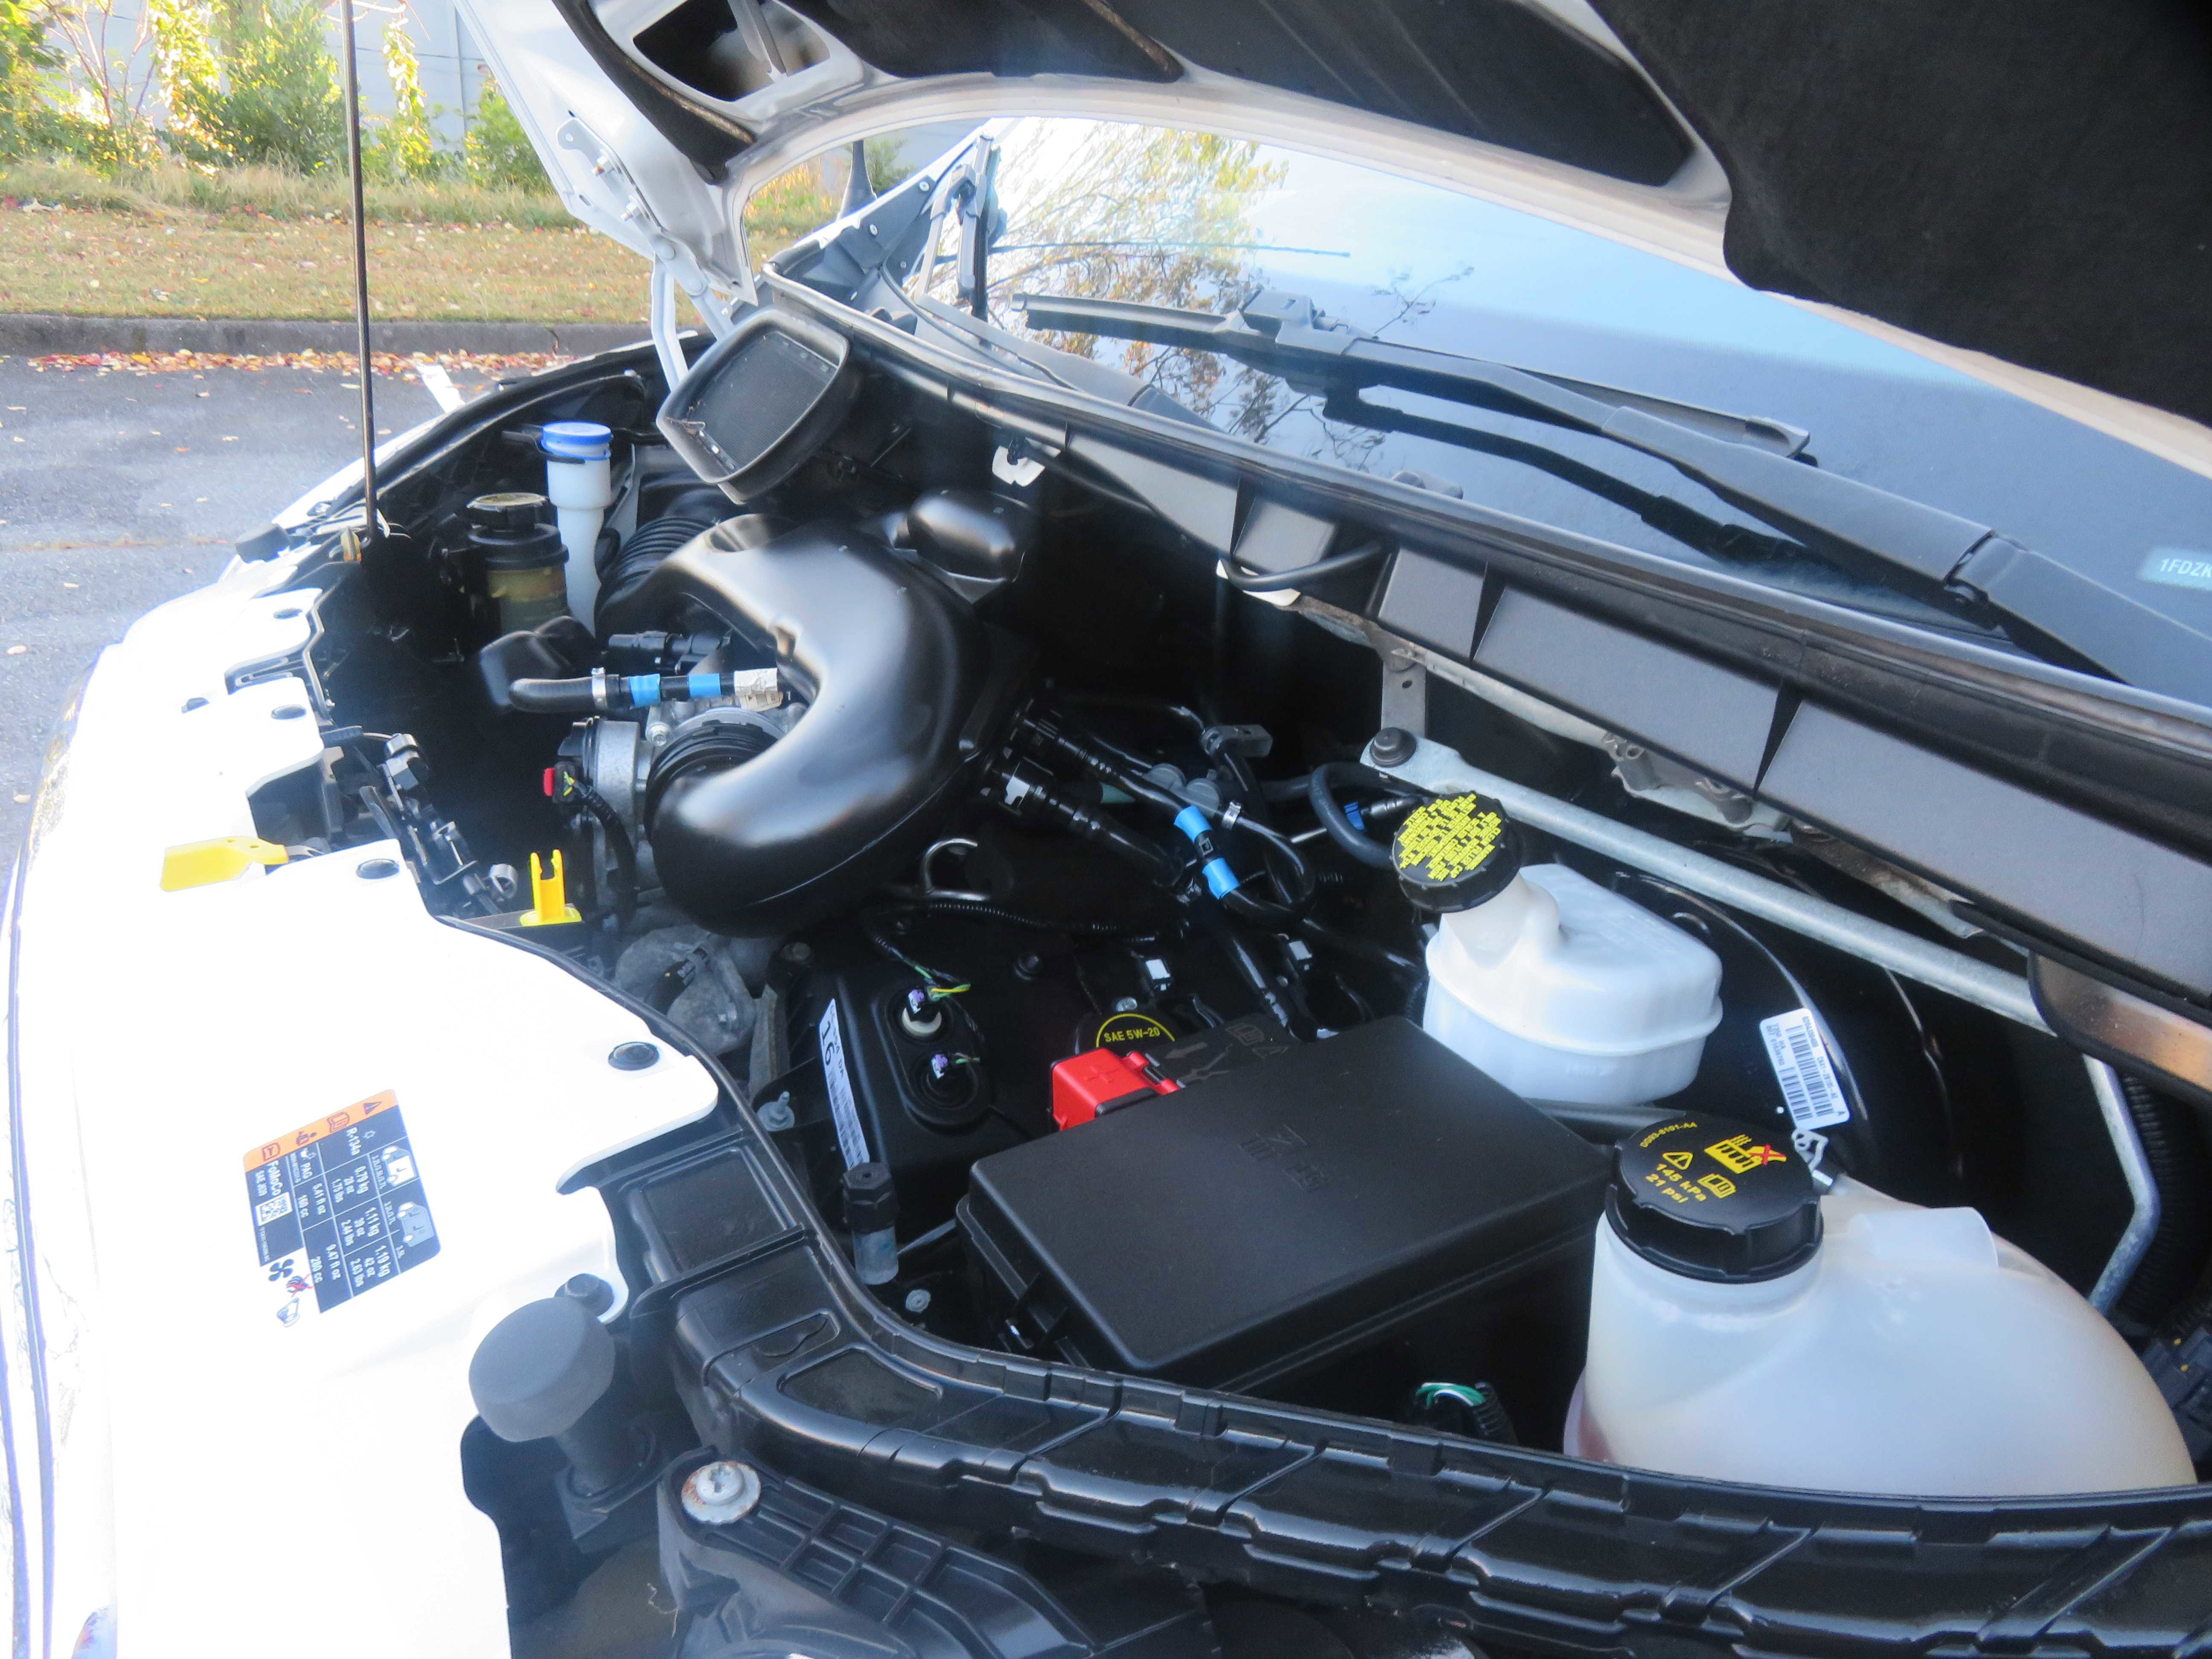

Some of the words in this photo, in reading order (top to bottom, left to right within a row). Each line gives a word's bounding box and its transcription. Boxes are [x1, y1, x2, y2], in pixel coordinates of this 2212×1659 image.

[1479, 825, 1501, 847] CLEAN
[1459, 844, 1484, 867] FILLER
[1449, 864, 1463, 878] CAP
[1104, 1030, 1125, 1042] SAE
[1128, 1027, 1160, 1040] 5W-20
[822, 1021, 835, 1065] 16
[345, 1126, 363, 1156] R-134a
[254, 1170, 265, 1185] SAE
[266, 1160, 284, 1196] FoMoCo
[300, 1161, 313, 1180] PAG
[353, 1164, 368, 1185] 0.79
[1656, 1164, 1682, 1182] 145
[331, 1177, 343, 1193] 1.75
[343, 1175, 355, 1187] 28
[355, 1180, 371, 1195] kg
[1645, 1173, 1666, 1187] 21
[311, 1182, 324, 1200] 5.41
[334, 1190, 346, 1204] lbs
[346, 1184, 355, 1194] oz
[297, 1193, 308, 1209] 160
[299, 1206, 309, 1219] cc
[316, 1204, 326, 1216] oz
[364, 1205, 379, 1225] 1.11
[341, 1218, 353, 1236] 2.44
[355, 1226, 365, 1237] oz
[366, 1222, 381, 1238] kg
[344, 1233, 356, 1247] lbs
[325, 1243, 338, 1263] 9.47
[374, 1243, 390, 1265] 1.19
[310, 1255, 322, 1273] 280
[350, 1257, 363, 1276] 2.63
[364, 1255, 375, 1268] 42
[313, 1270, 323, 1284] cc
[330, 1267, 341, 1281] oz
[366, 1266, 375, 1278] oz
[376, 1262, 392, 1279] kg
[354, 1273, 366, 1288] lbs
